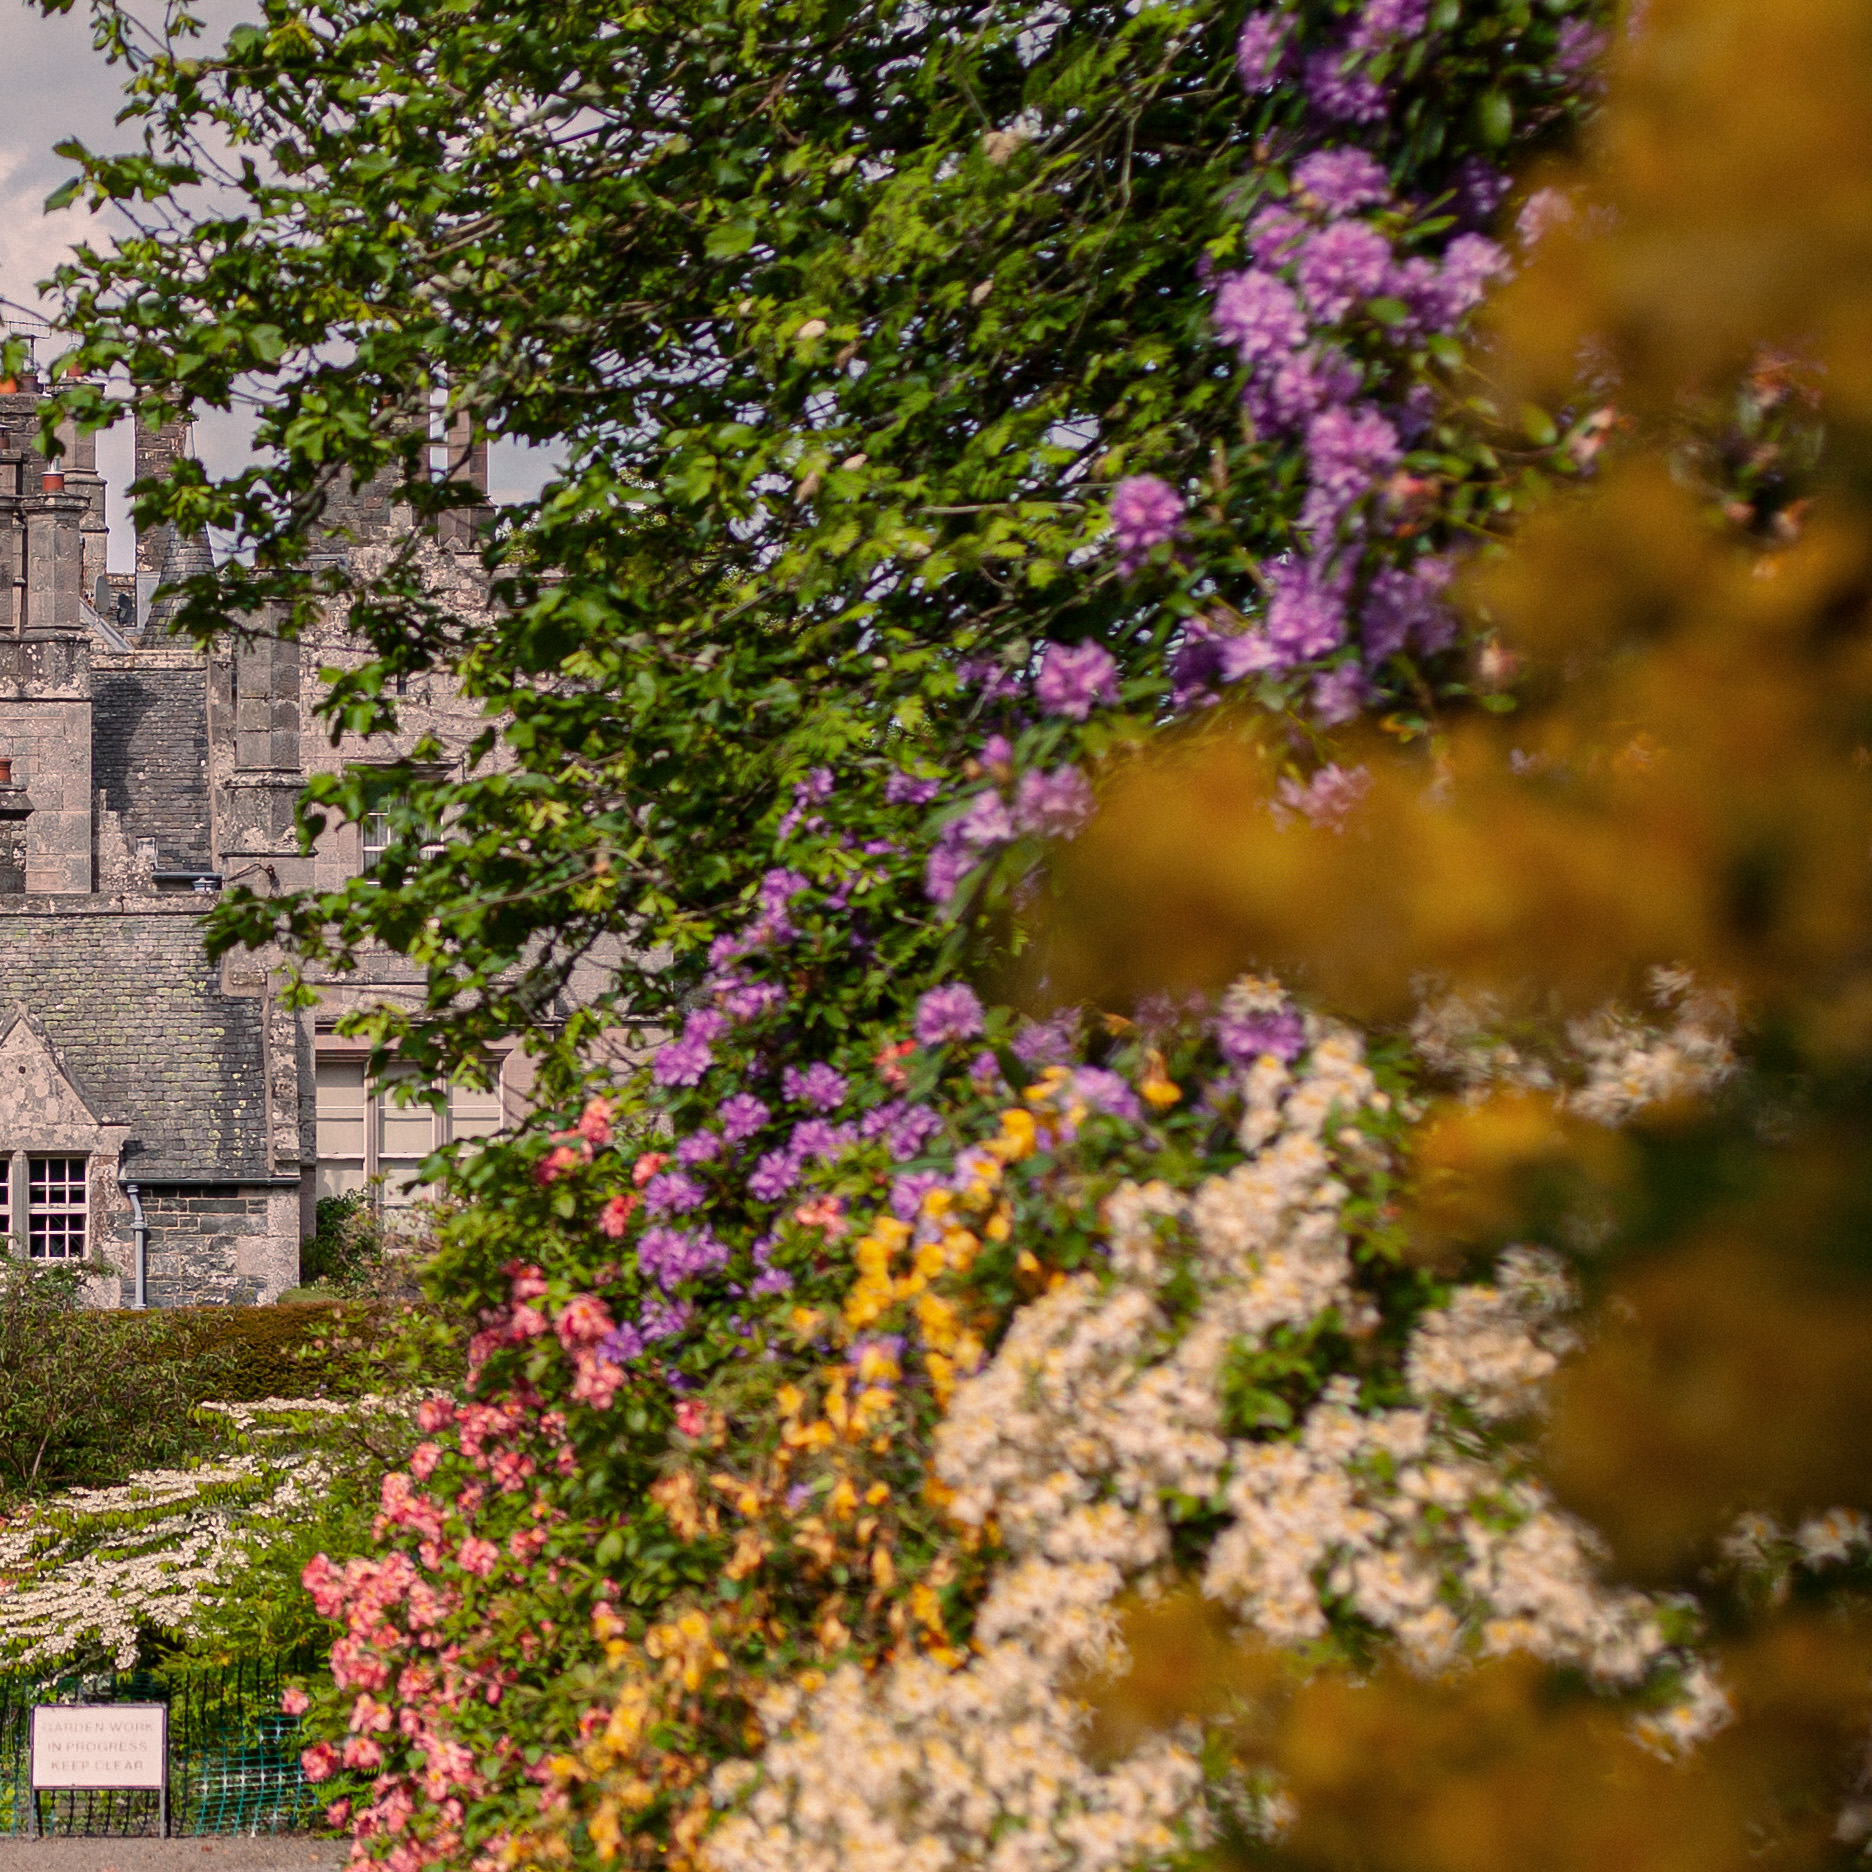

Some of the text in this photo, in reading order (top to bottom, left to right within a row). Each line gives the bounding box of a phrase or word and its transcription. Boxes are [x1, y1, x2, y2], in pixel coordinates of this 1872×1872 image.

[41, 1720, 153, 1732] GARDEN WORK
[47, 1740, 148, 1752] IN PROGRESS
[50, 1759, 144, 1771] KEEP CLEAR
